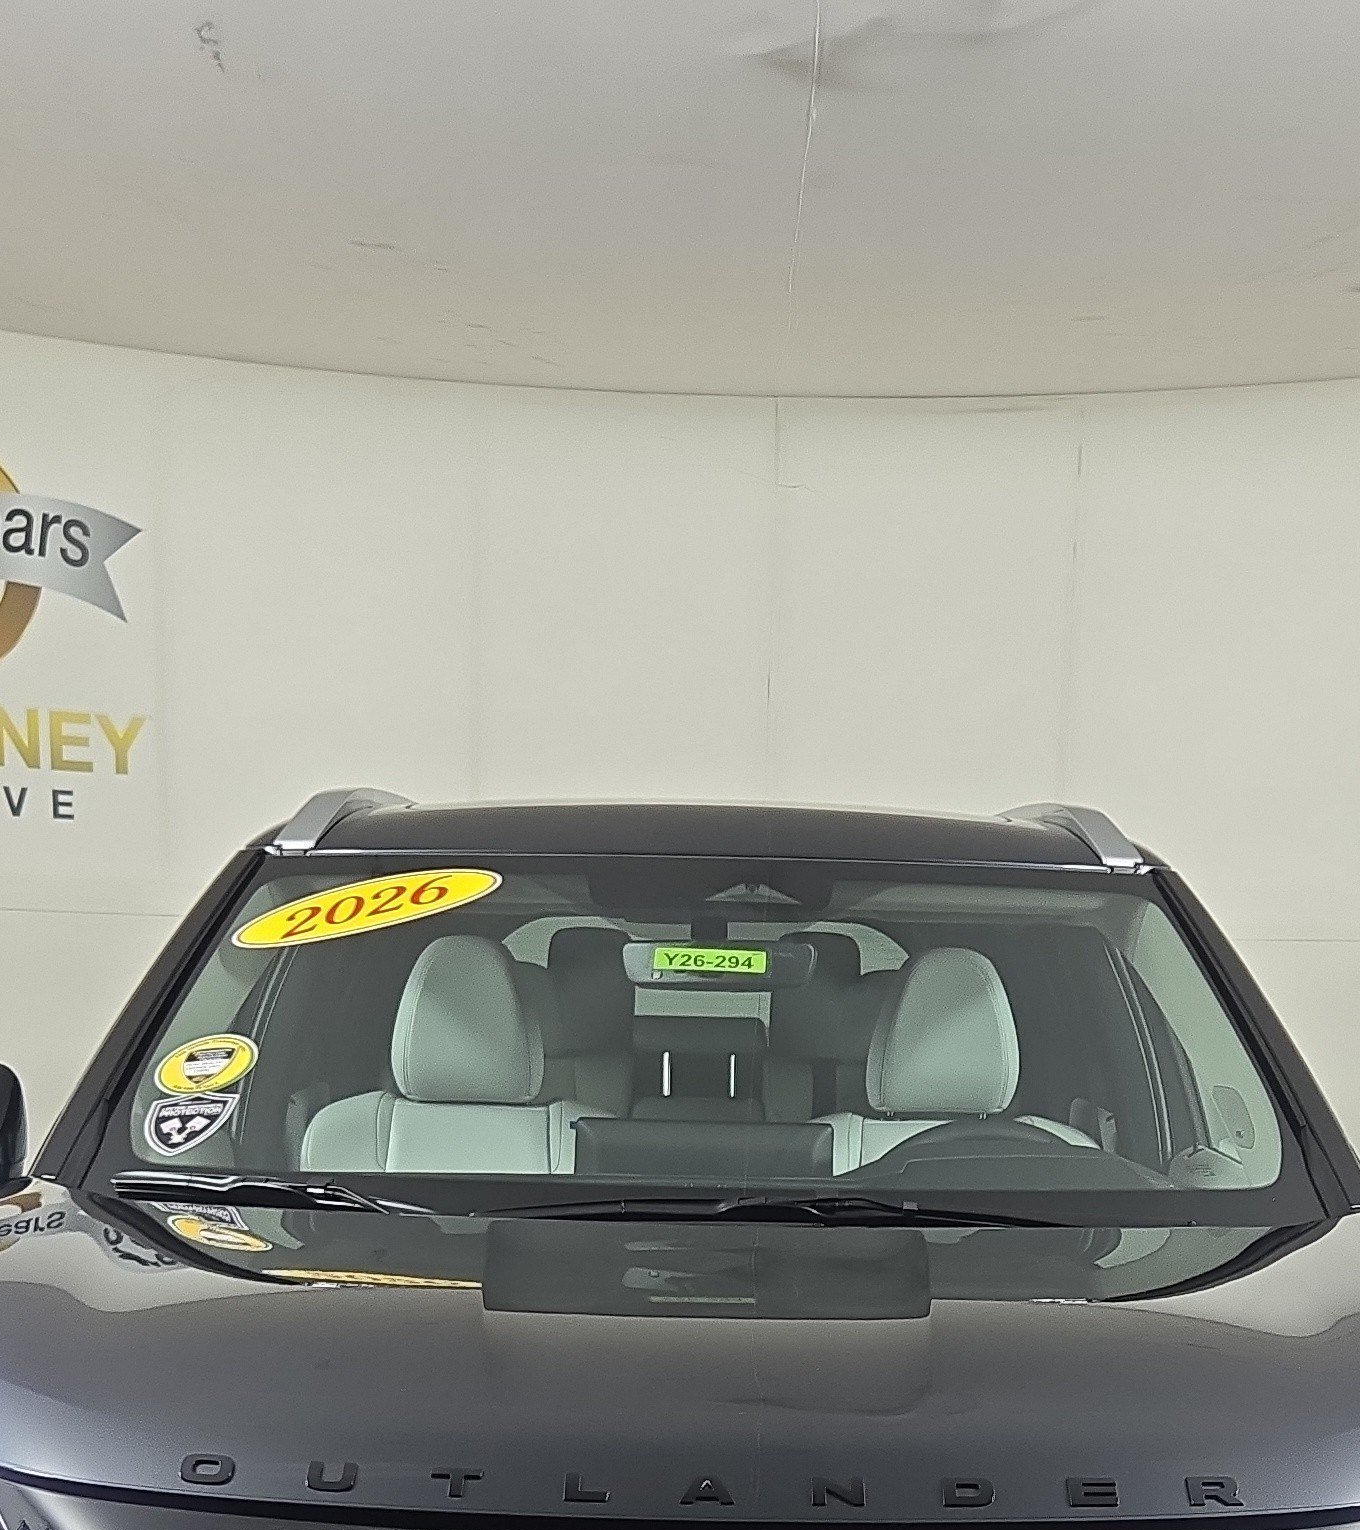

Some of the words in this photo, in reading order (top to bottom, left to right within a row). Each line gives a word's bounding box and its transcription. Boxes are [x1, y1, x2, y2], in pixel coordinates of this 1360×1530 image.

[281, 875, 451, 940] 2026
[664, 952, 754, 969] Y26-294
[180, 1452, 1245, 1507] OUTLANDER
